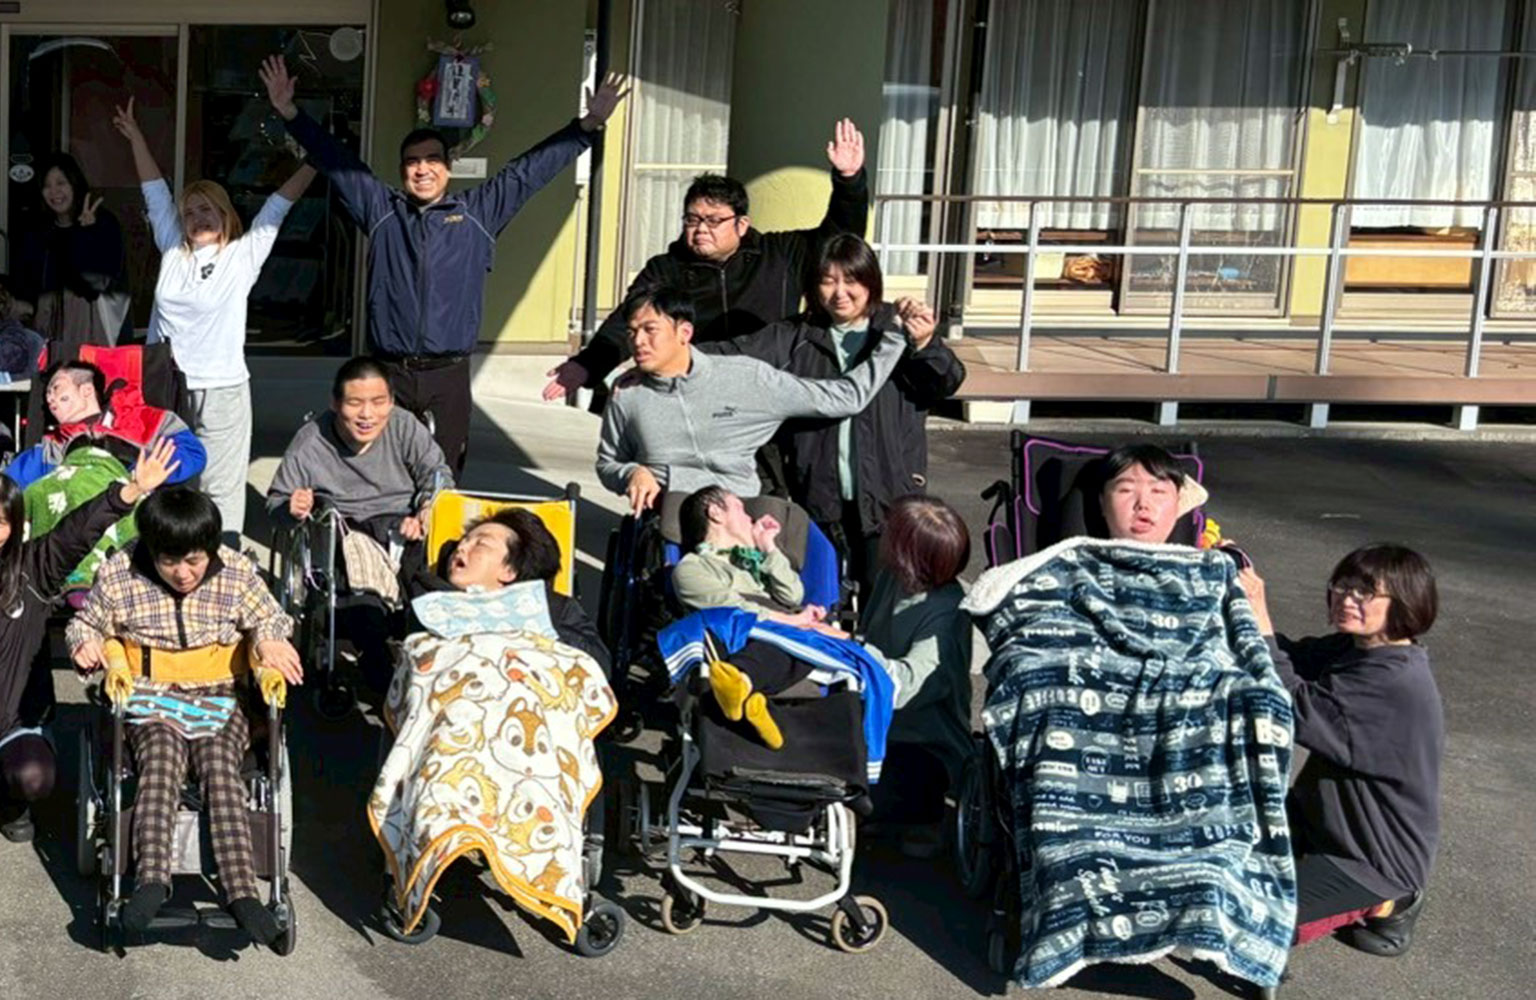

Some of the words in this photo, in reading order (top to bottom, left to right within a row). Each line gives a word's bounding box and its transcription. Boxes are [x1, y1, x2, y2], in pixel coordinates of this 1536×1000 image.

[1151, 613, 1179, 629] 30
[1174, 773, 1203, 793] 30
[1094, 831, 1121, 839] FOR
[1125, 834, 1151, 845] YOU
